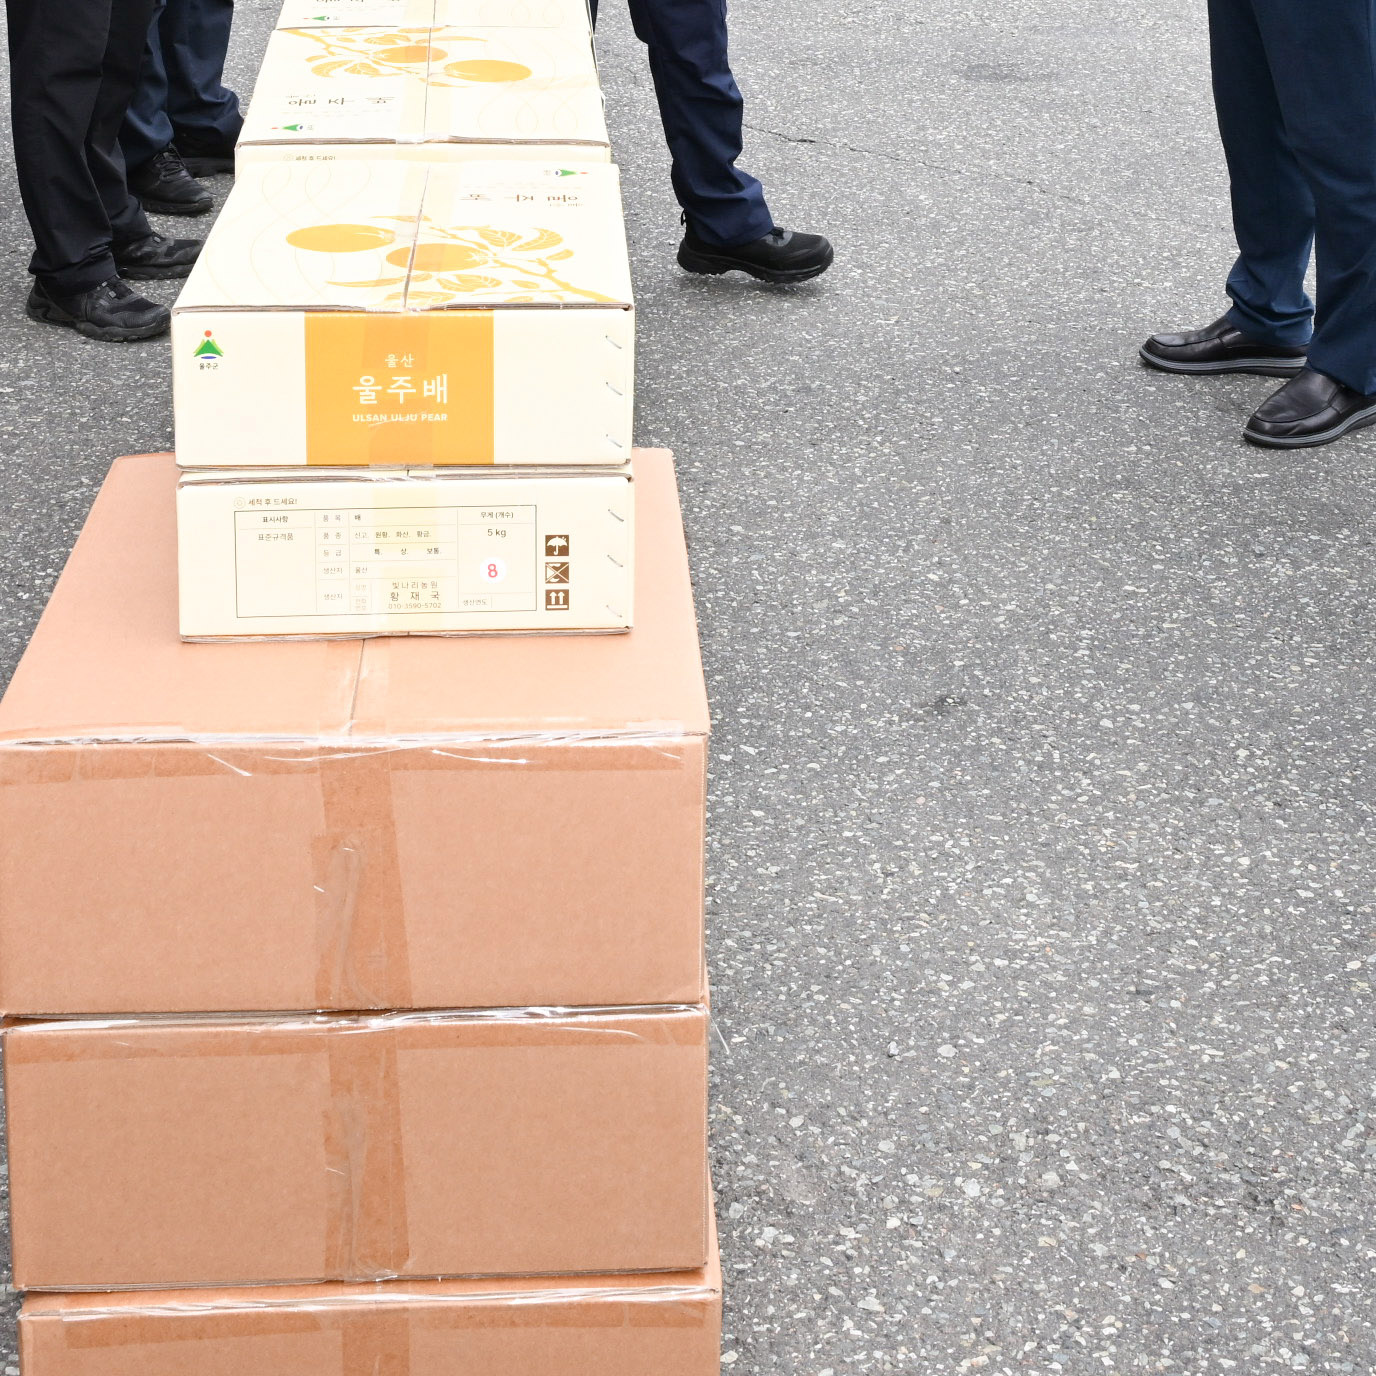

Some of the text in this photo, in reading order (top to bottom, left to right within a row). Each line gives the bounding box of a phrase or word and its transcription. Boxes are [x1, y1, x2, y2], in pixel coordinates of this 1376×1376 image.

[385, 353, 414, 368] 울산
[198, 362, 219, 370] 울주군
[352, 373, 449, 404] 울주배
[352, 412, 448, 422] ULSAN ULJU PEAR
[248, 497, 298, 506] 세척 후 드세요!
[262, 515, 289, 523] 표시사항
[494, 510, 514, 520] (개수)
[258, 532, 294, 542] 표준규격품
[487, 528, 507, 538] 5 kg
[487, 563, 499, 578] 8
